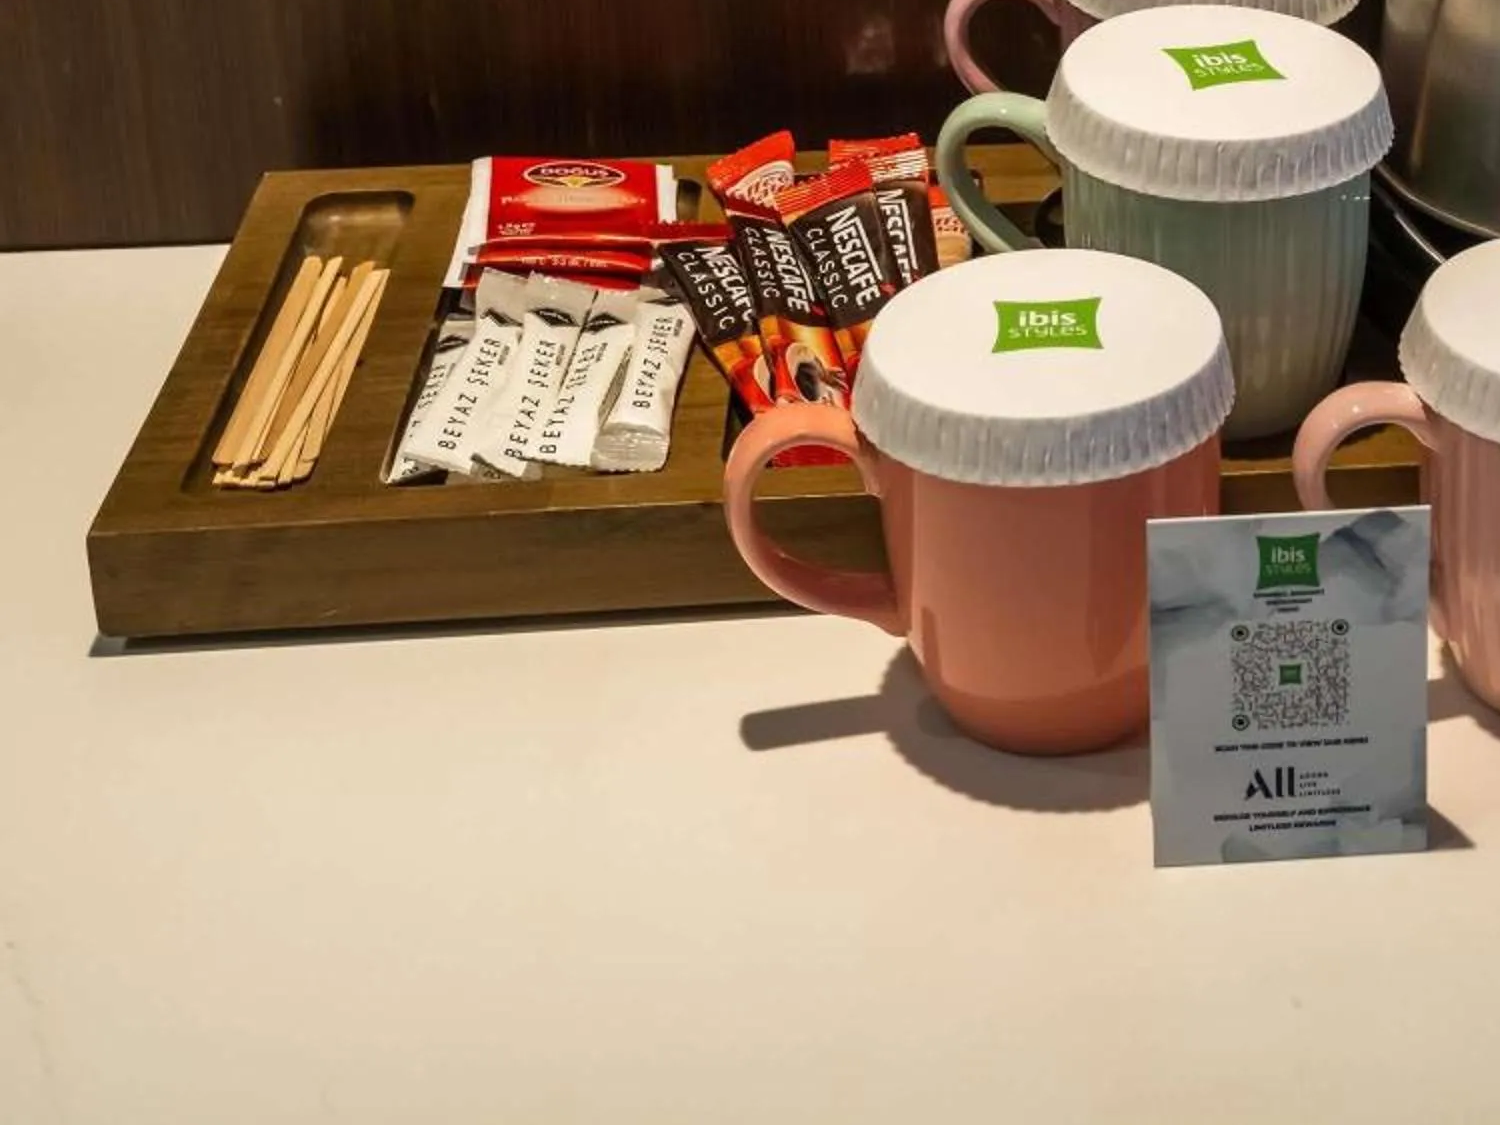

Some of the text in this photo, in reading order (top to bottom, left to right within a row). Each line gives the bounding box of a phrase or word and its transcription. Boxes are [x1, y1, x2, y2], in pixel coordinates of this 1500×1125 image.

[1192, 52, 1248, 68] ibis
[676, 250, 736, 332] CLASSIC
[744, 225, 781, 301] CLASSIC
[805, 226, 849, 309] CLASSIC
[1019, 310, 1077, 327] ibis
[437, 337, 501, 451] BEYAZ ŞEKER
[504, 394, 541, 460] BEYAZ
[527, 339, 558, 389] ŞEKER
[632, 356, 662, 409] BEYAZ
[539, 393, 576, 455] BEYAZ
[1271, 545, 1306, 564] ibis
